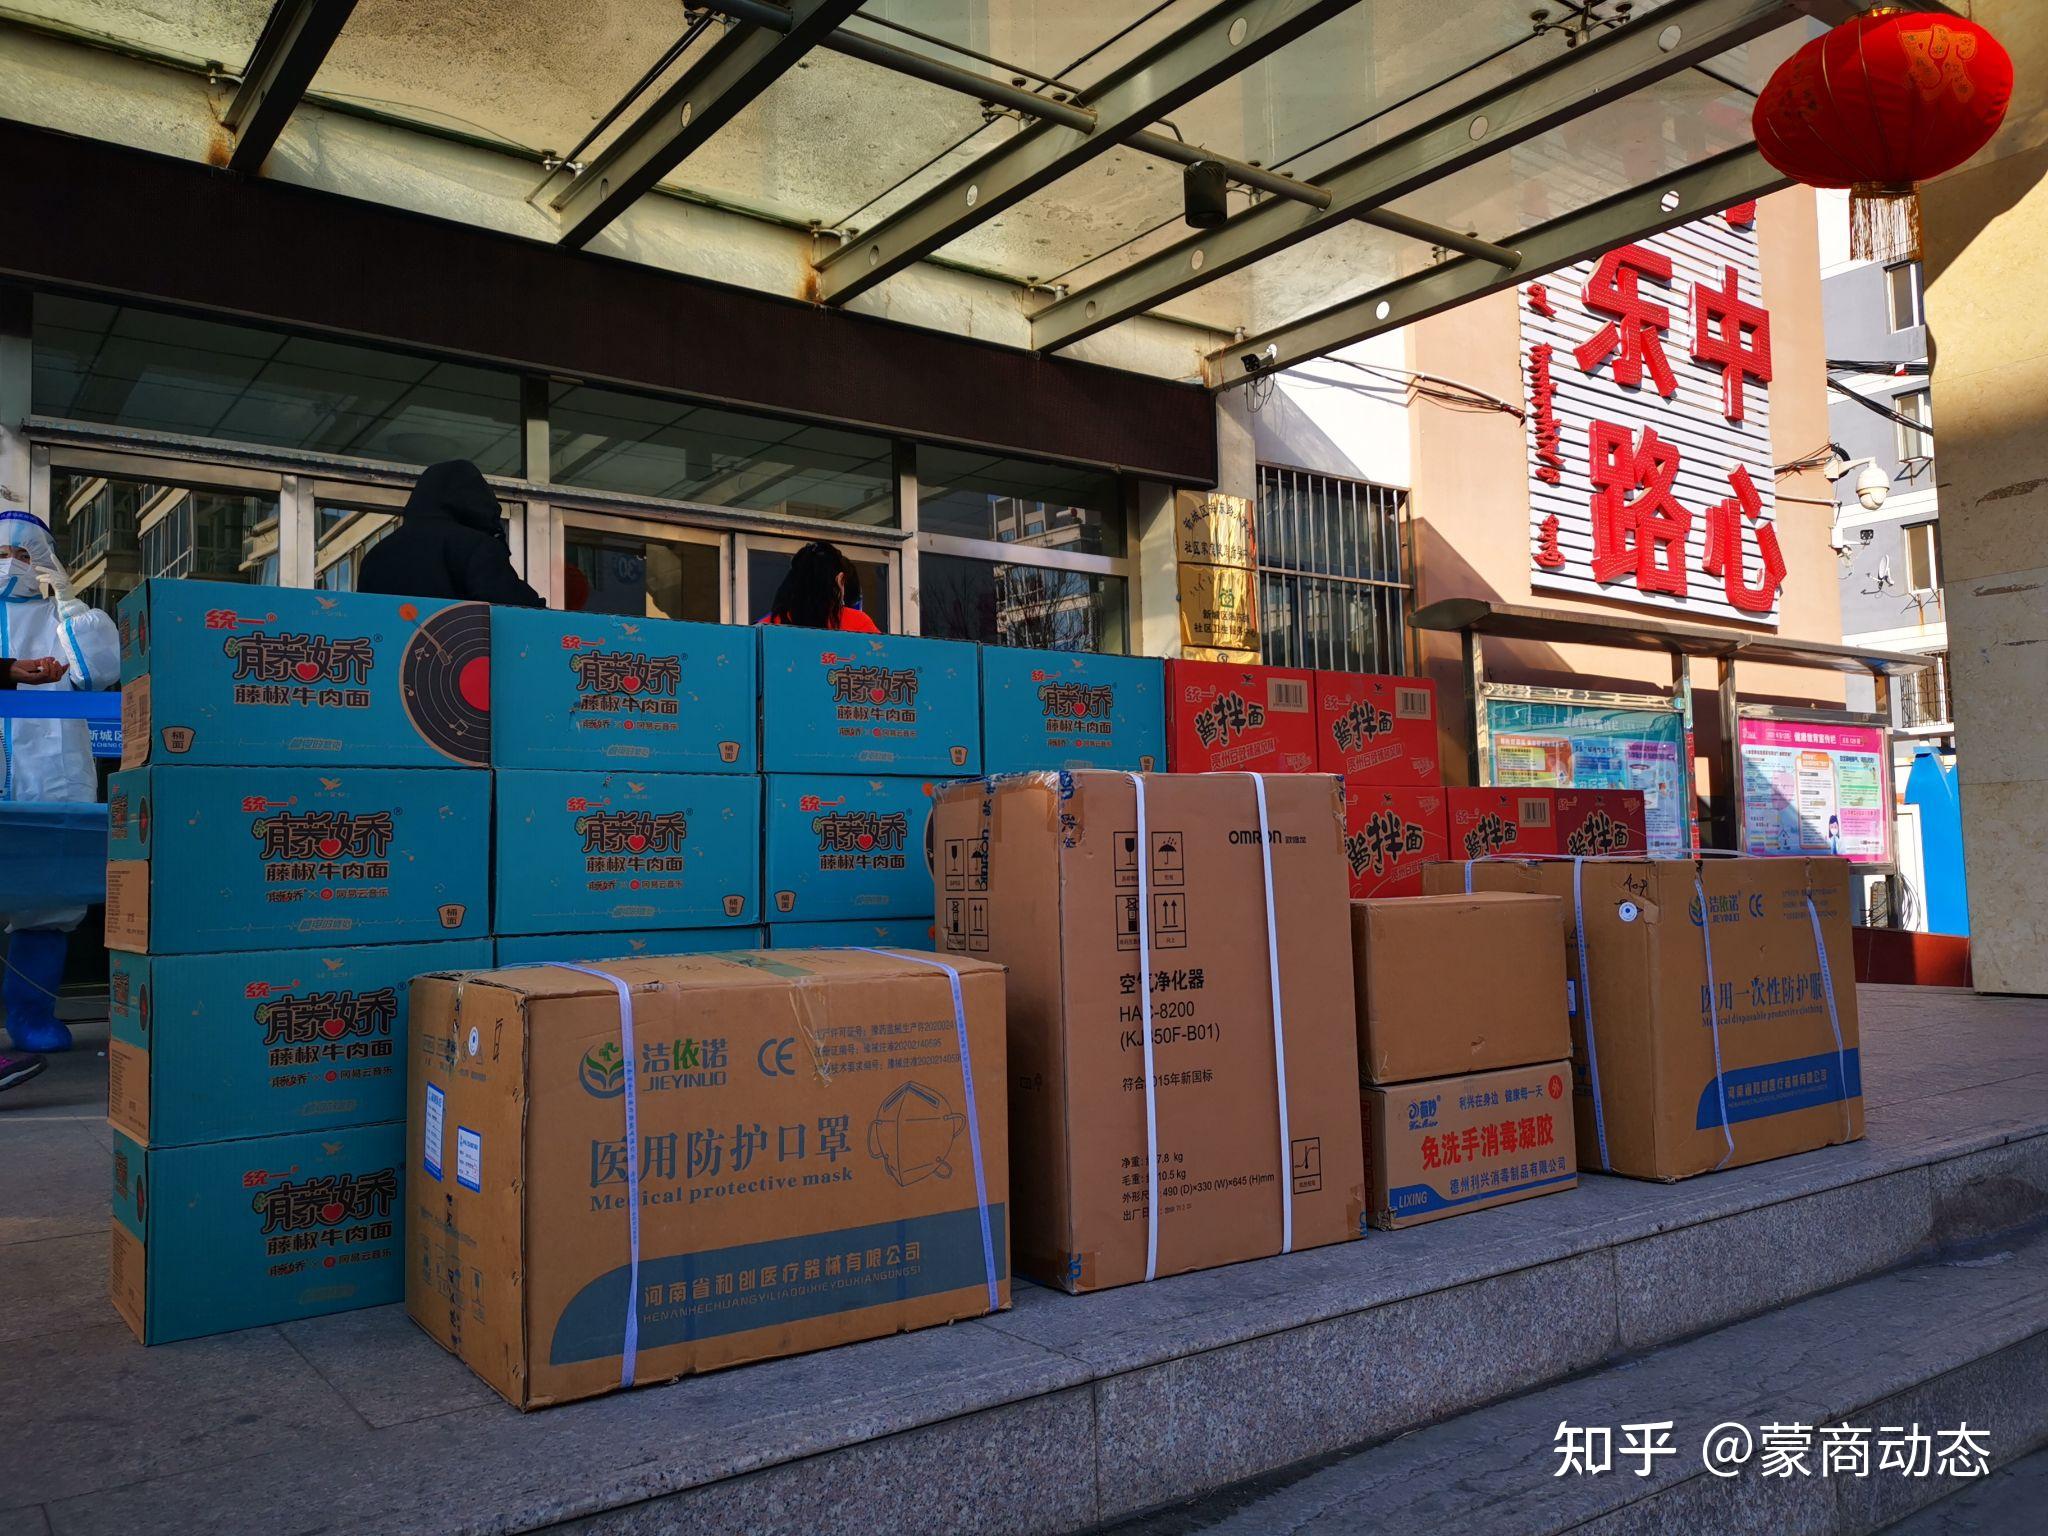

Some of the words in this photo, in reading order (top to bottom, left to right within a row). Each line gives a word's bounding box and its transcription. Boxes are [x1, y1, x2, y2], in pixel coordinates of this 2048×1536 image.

[205, 609, 265, 630] 统一
[561, 635, 598, 650] 统一
[821, 652, 852, 664] 统一
[1031, 670, 1056, 682] 统一
[234, 685, 370, 707] 藤椒牛肉面
[580, 695, 679, 715] 藤椒牛肉面
[837, 705, 916, 723] 藤椒牛肉面
[1194, 690, 1265, 749] 酱拌面
[1045, 718, 1111, 734] 藤椒牛肉面
[1332, 699, 1393, 753] 酱拌面
[242, 796, 288, 812] 统一
[567, 798, 603, 812] 统一
[800, 796, 838, 811] 统一
[1347, 810, 1424, 878] 酱拌面
[1463, 812, 1517, 859] 酱拌面
[265, 862, 388, 882] 藤椒牛肉面
[586, 856, 683, 873] 藤椒牛肉面
[820, 855, 905, 871] 藤椒牛肉面
[1748, 894, 1764, 918] CE
[246, 981, 291, 999] 统一
[1700, 972, 1824, 1014] 医用一次性防护服
[1702, 1013, 1732, 1028] Meical
[1120, 1022, 1221, 1053] (KJ50F-B01)
[269, 1040, 392, 1067] 藤椒牛肉面
[642, 1038, 729, 1074] 洁依诺
[758, 1036, 797, 1077] CE
[643, 1069, 728, 1093] JIEYINUO
[1122, 1069, 1214, 1093] 符合015年新国标
[1459, 1092, 1499, 1111] 利兴在身边
[1505, 1084, 1544, 1103] 健康每一天
[589, 1115, 853, 1191] 医用防护口罩
[1421, 1113, 1554, 1171] 免洗手消毒凝胶
[1174, 1152, 1184, 1163] kg
[243, 1169, 290, 1187] 统一
[1176, 1168, 1187, 1180] kg
[1450, 1156, 1566, 1195] 德州利兴消毒制品有限公司
[590, 1185, 682, 1212] Meical
[688, 1169, 797, 1209] protective
[803, 1166, 853, 1188] mask
[1398, 1191, 1428, 1210] LIXING
[266, 1222, 392, 1256] 藤椒牛肉面
[643, 1241, 921, 1306] 河南省和创医疗器械有限公司
